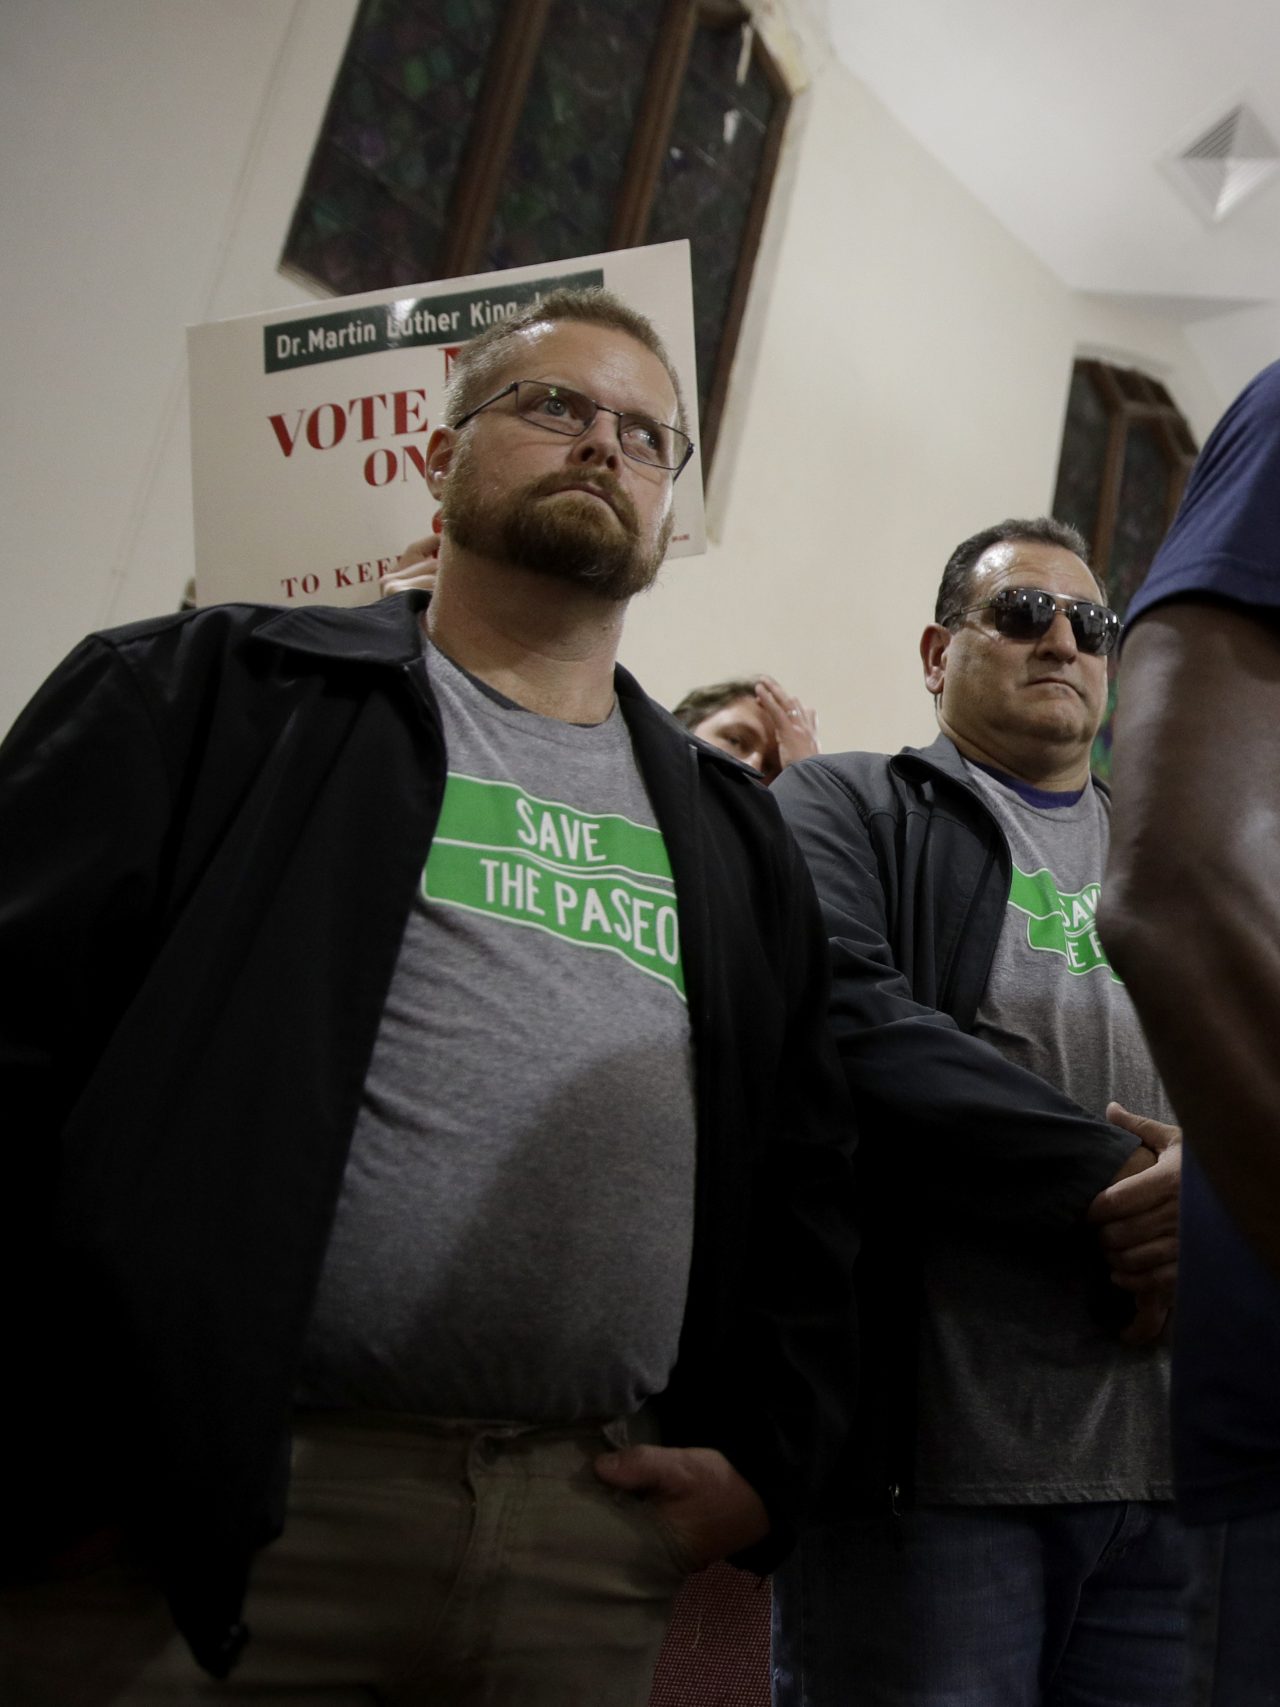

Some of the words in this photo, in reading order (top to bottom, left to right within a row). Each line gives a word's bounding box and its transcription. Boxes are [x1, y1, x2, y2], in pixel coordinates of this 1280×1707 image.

[387, 309, 460, 338] Luther
[267, 389, 428, 458] VOTE
[364, 445, 427, 487] ON
[281, 573, 319, 598] TO
[334, 555, 403, 588] KEE
[516, 798, 607, 862] SAVE
[479, 858, 546, 916] THE
[553, 880, 679, 966] PASEO
